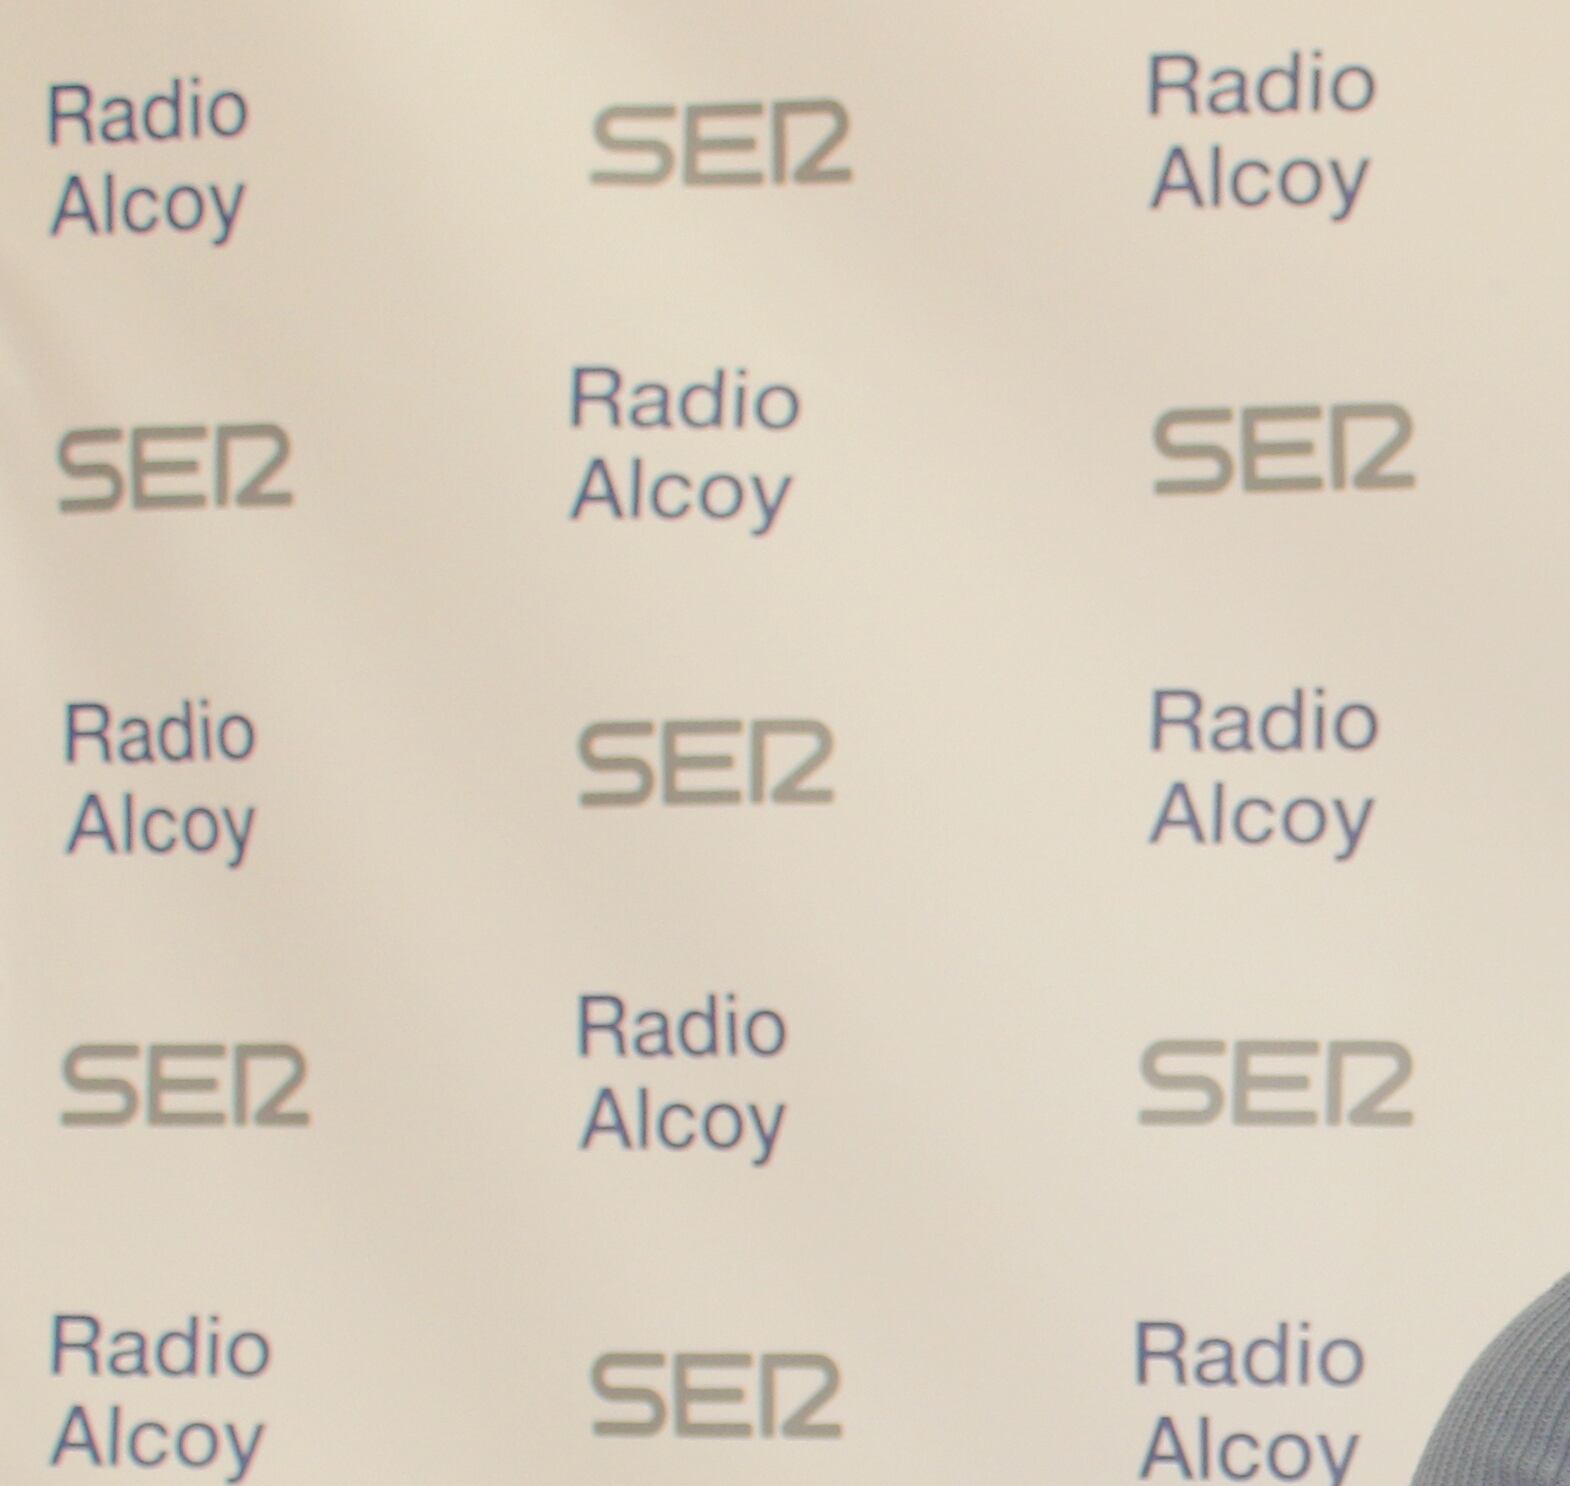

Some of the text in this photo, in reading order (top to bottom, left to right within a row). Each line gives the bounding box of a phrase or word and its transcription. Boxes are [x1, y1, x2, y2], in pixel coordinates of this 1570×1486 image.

[49, 78, 248, 146] Radio
[1149, 51, 1376, 116] Radio
[590, 98, 853, 187] SER
[50, 173, 246, 247] Alcoy
[1150, 145, 1370, 223] Alcoy
[571, 365, 801, 431] Radio
[57, 422, 293, 514] SER
[1153, 402, 1416, 496] SER
[570, 457, 793, 537] Alcoy
[65, 700, 256, 764] Radio
[1151, 687, 1379, 753] Radio
[577, 718, 834, 808] SER
[66, 792, 255, 870] Alcoy
[1149, 781, 1375, 862] Alcoy
[579, 993, 787, 1058] Radio
[60, 1042, 310, 1127] SER
[1138, 1039, 1414, 1127] SER
[580, 1086, 786, 1167] Alcoy
[51, 1313, 271, 1378] Radio
[1136, 1320, 1365, 1387] Radio
[590, 1352, 843, 1439] SER
[50, 1404, 265, 1485] Alcoy
